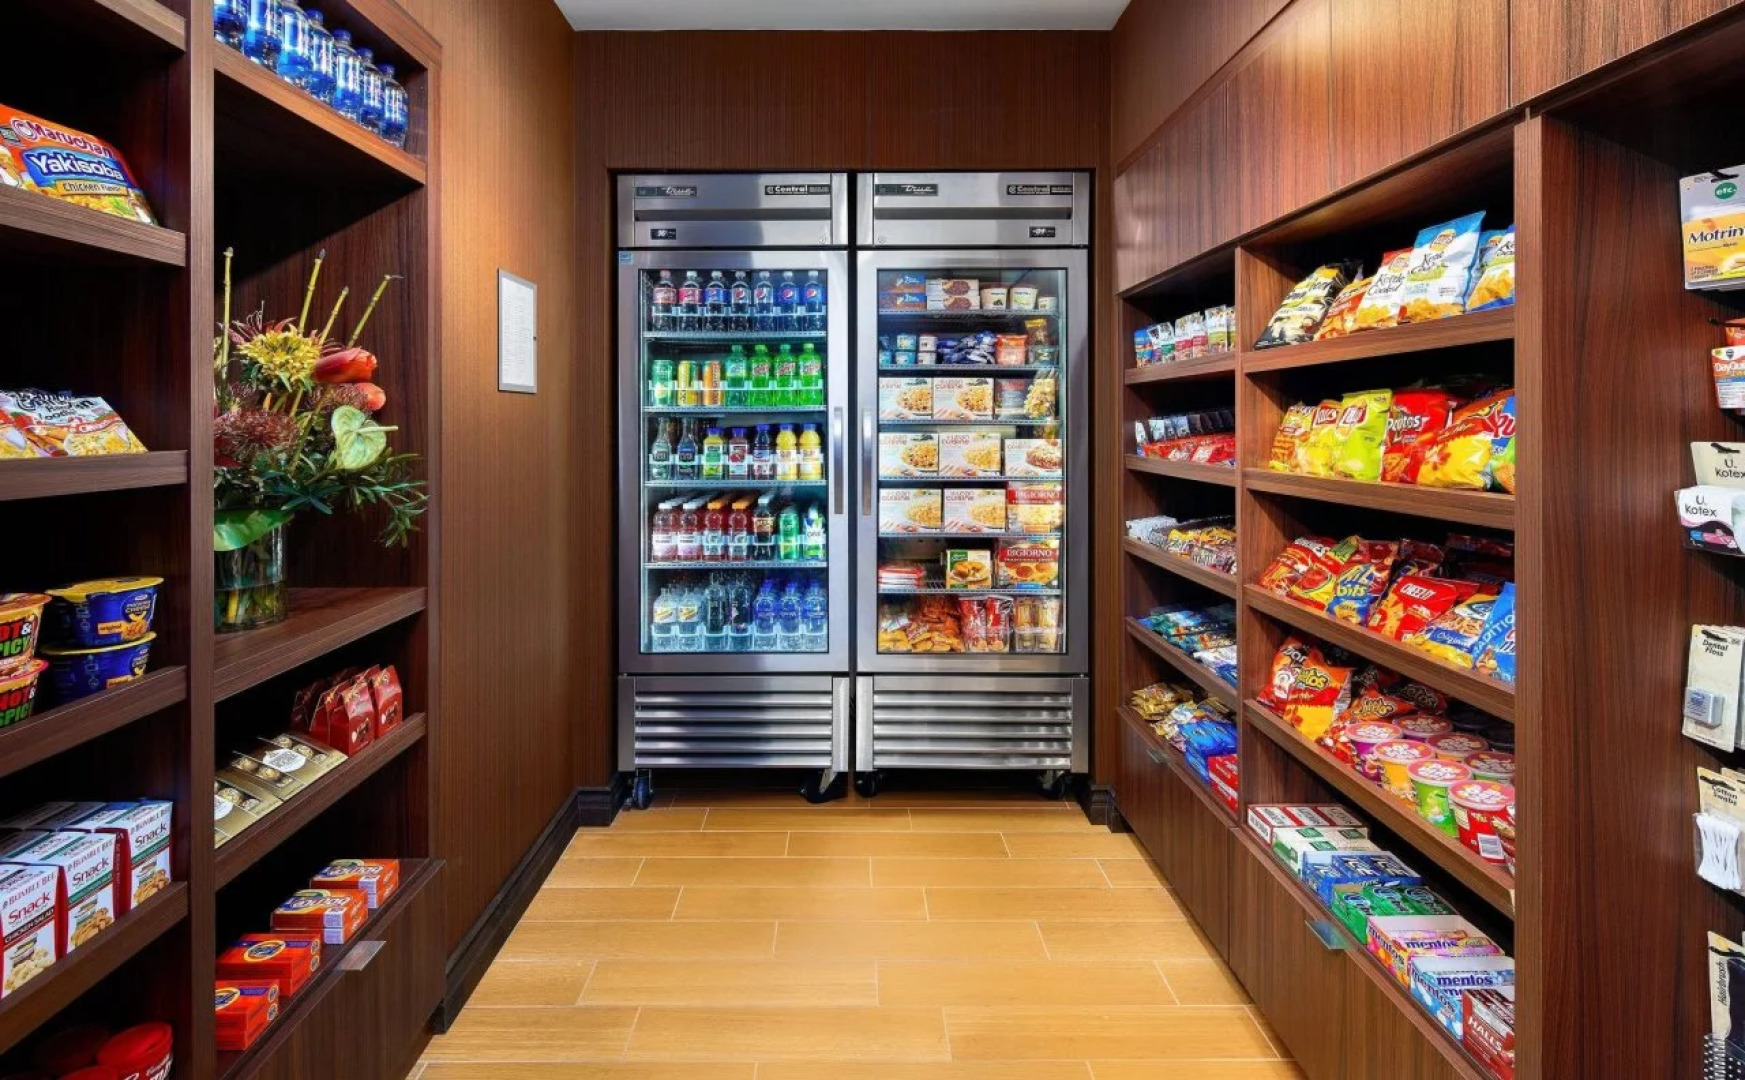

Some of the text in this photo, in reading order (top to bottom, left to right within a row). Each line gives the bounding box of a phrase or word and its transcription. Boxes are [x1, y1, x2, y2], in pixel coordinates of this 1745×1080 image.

[27, 121, 113, 158] Maruchan
[30, 154, 124, 180] Yakisoba
[1688, 226, 1744, 245] Motrin
[1685, 504, 1717, 517] Kotex
[0, 622, 22, 641] OT
[1472, 614, 1514, 658] RADITIO
[1702, 639, 1729, 651] Dental
[1705, 646, 1724, 657] Floss
[135, 822, 167, 845] Snack
[72, 857, 109, 883] Snack
[8, 891, 50, 921] Snack
[1406, 939, 1459, 949] mentos
[1437, 974, 1494, 986] mentos
[1467, 1016, 1503, 1051] HALLS
